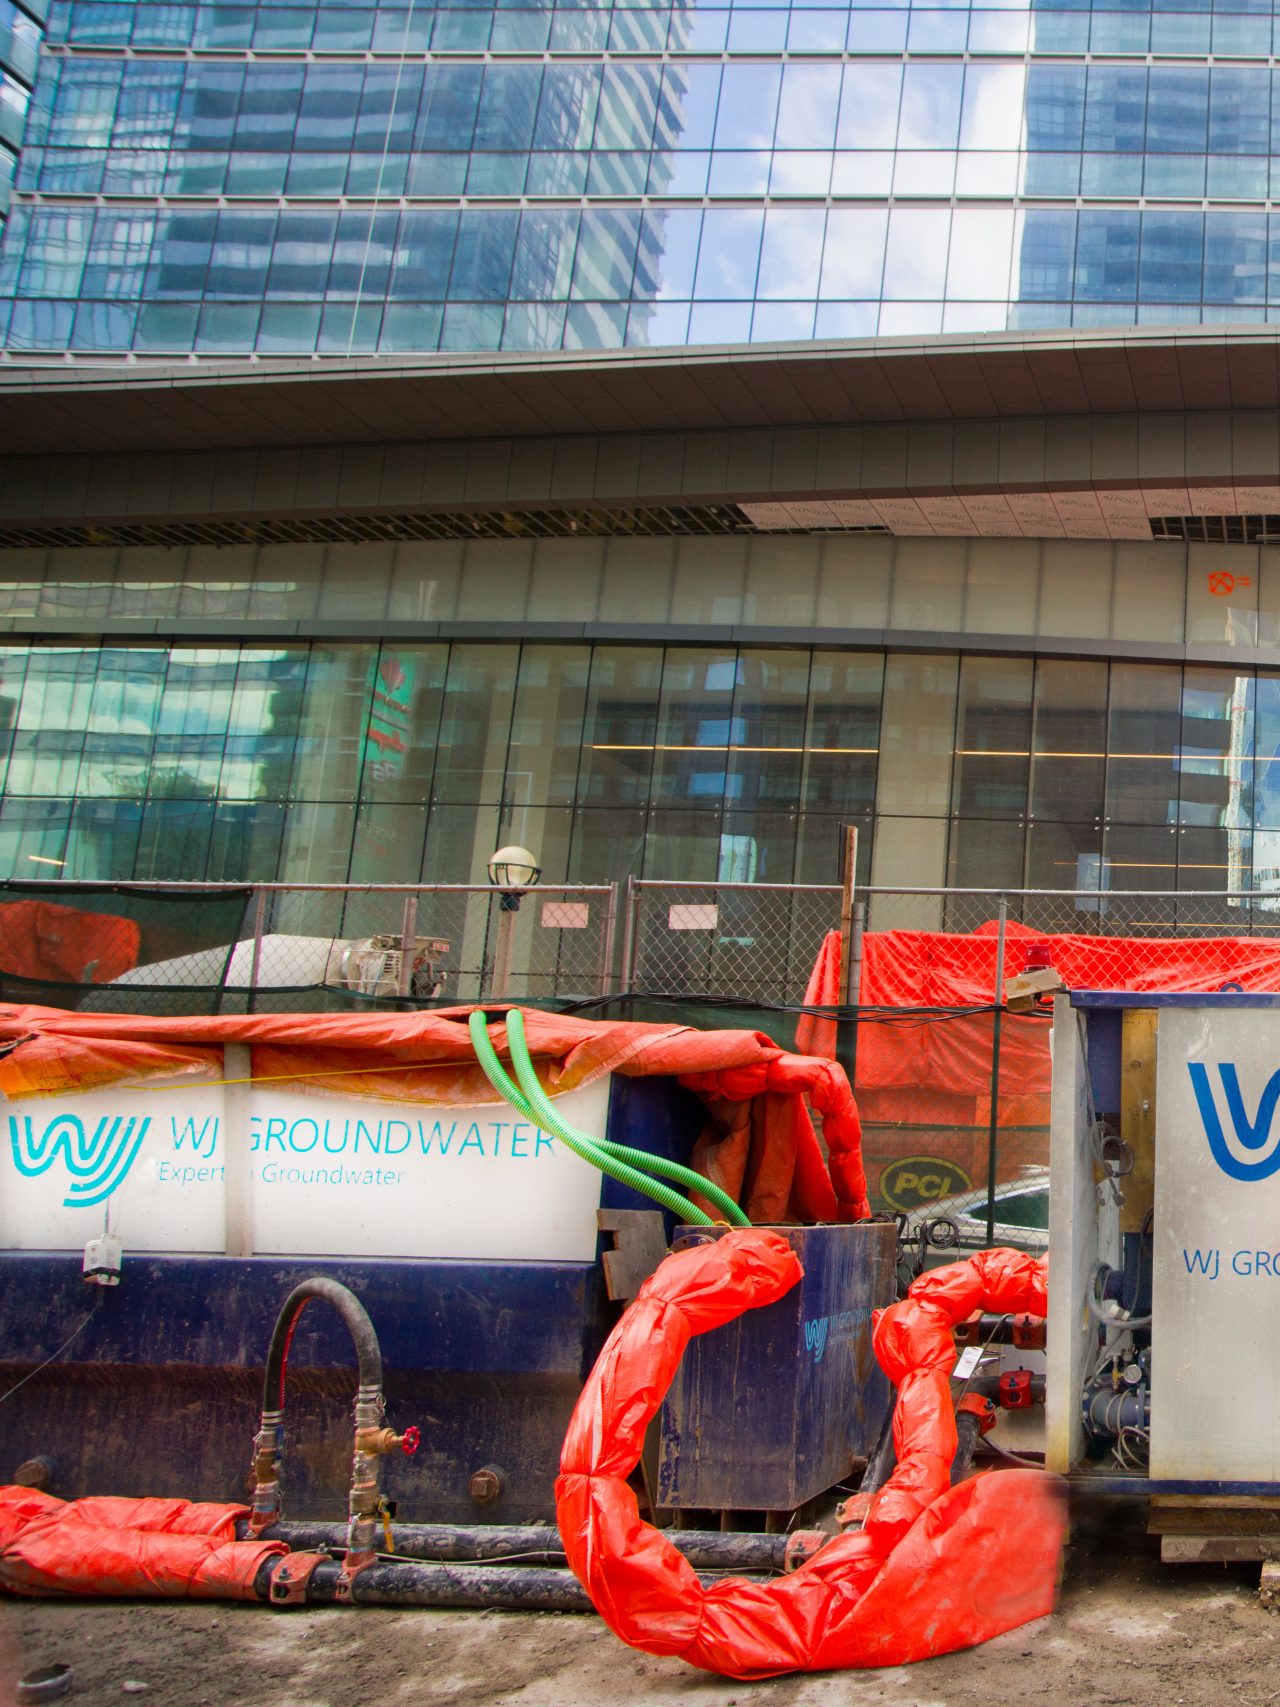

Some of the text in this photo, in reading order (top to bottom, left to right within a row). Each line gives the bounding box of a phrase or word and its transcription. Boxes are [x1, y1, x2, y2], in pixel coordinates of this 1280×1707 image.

[171, 1116, 219, 1159] WJ
[262, 1162, 406, 1185] Groundwater
[1183, 1249, 1220, 1279] WJ
